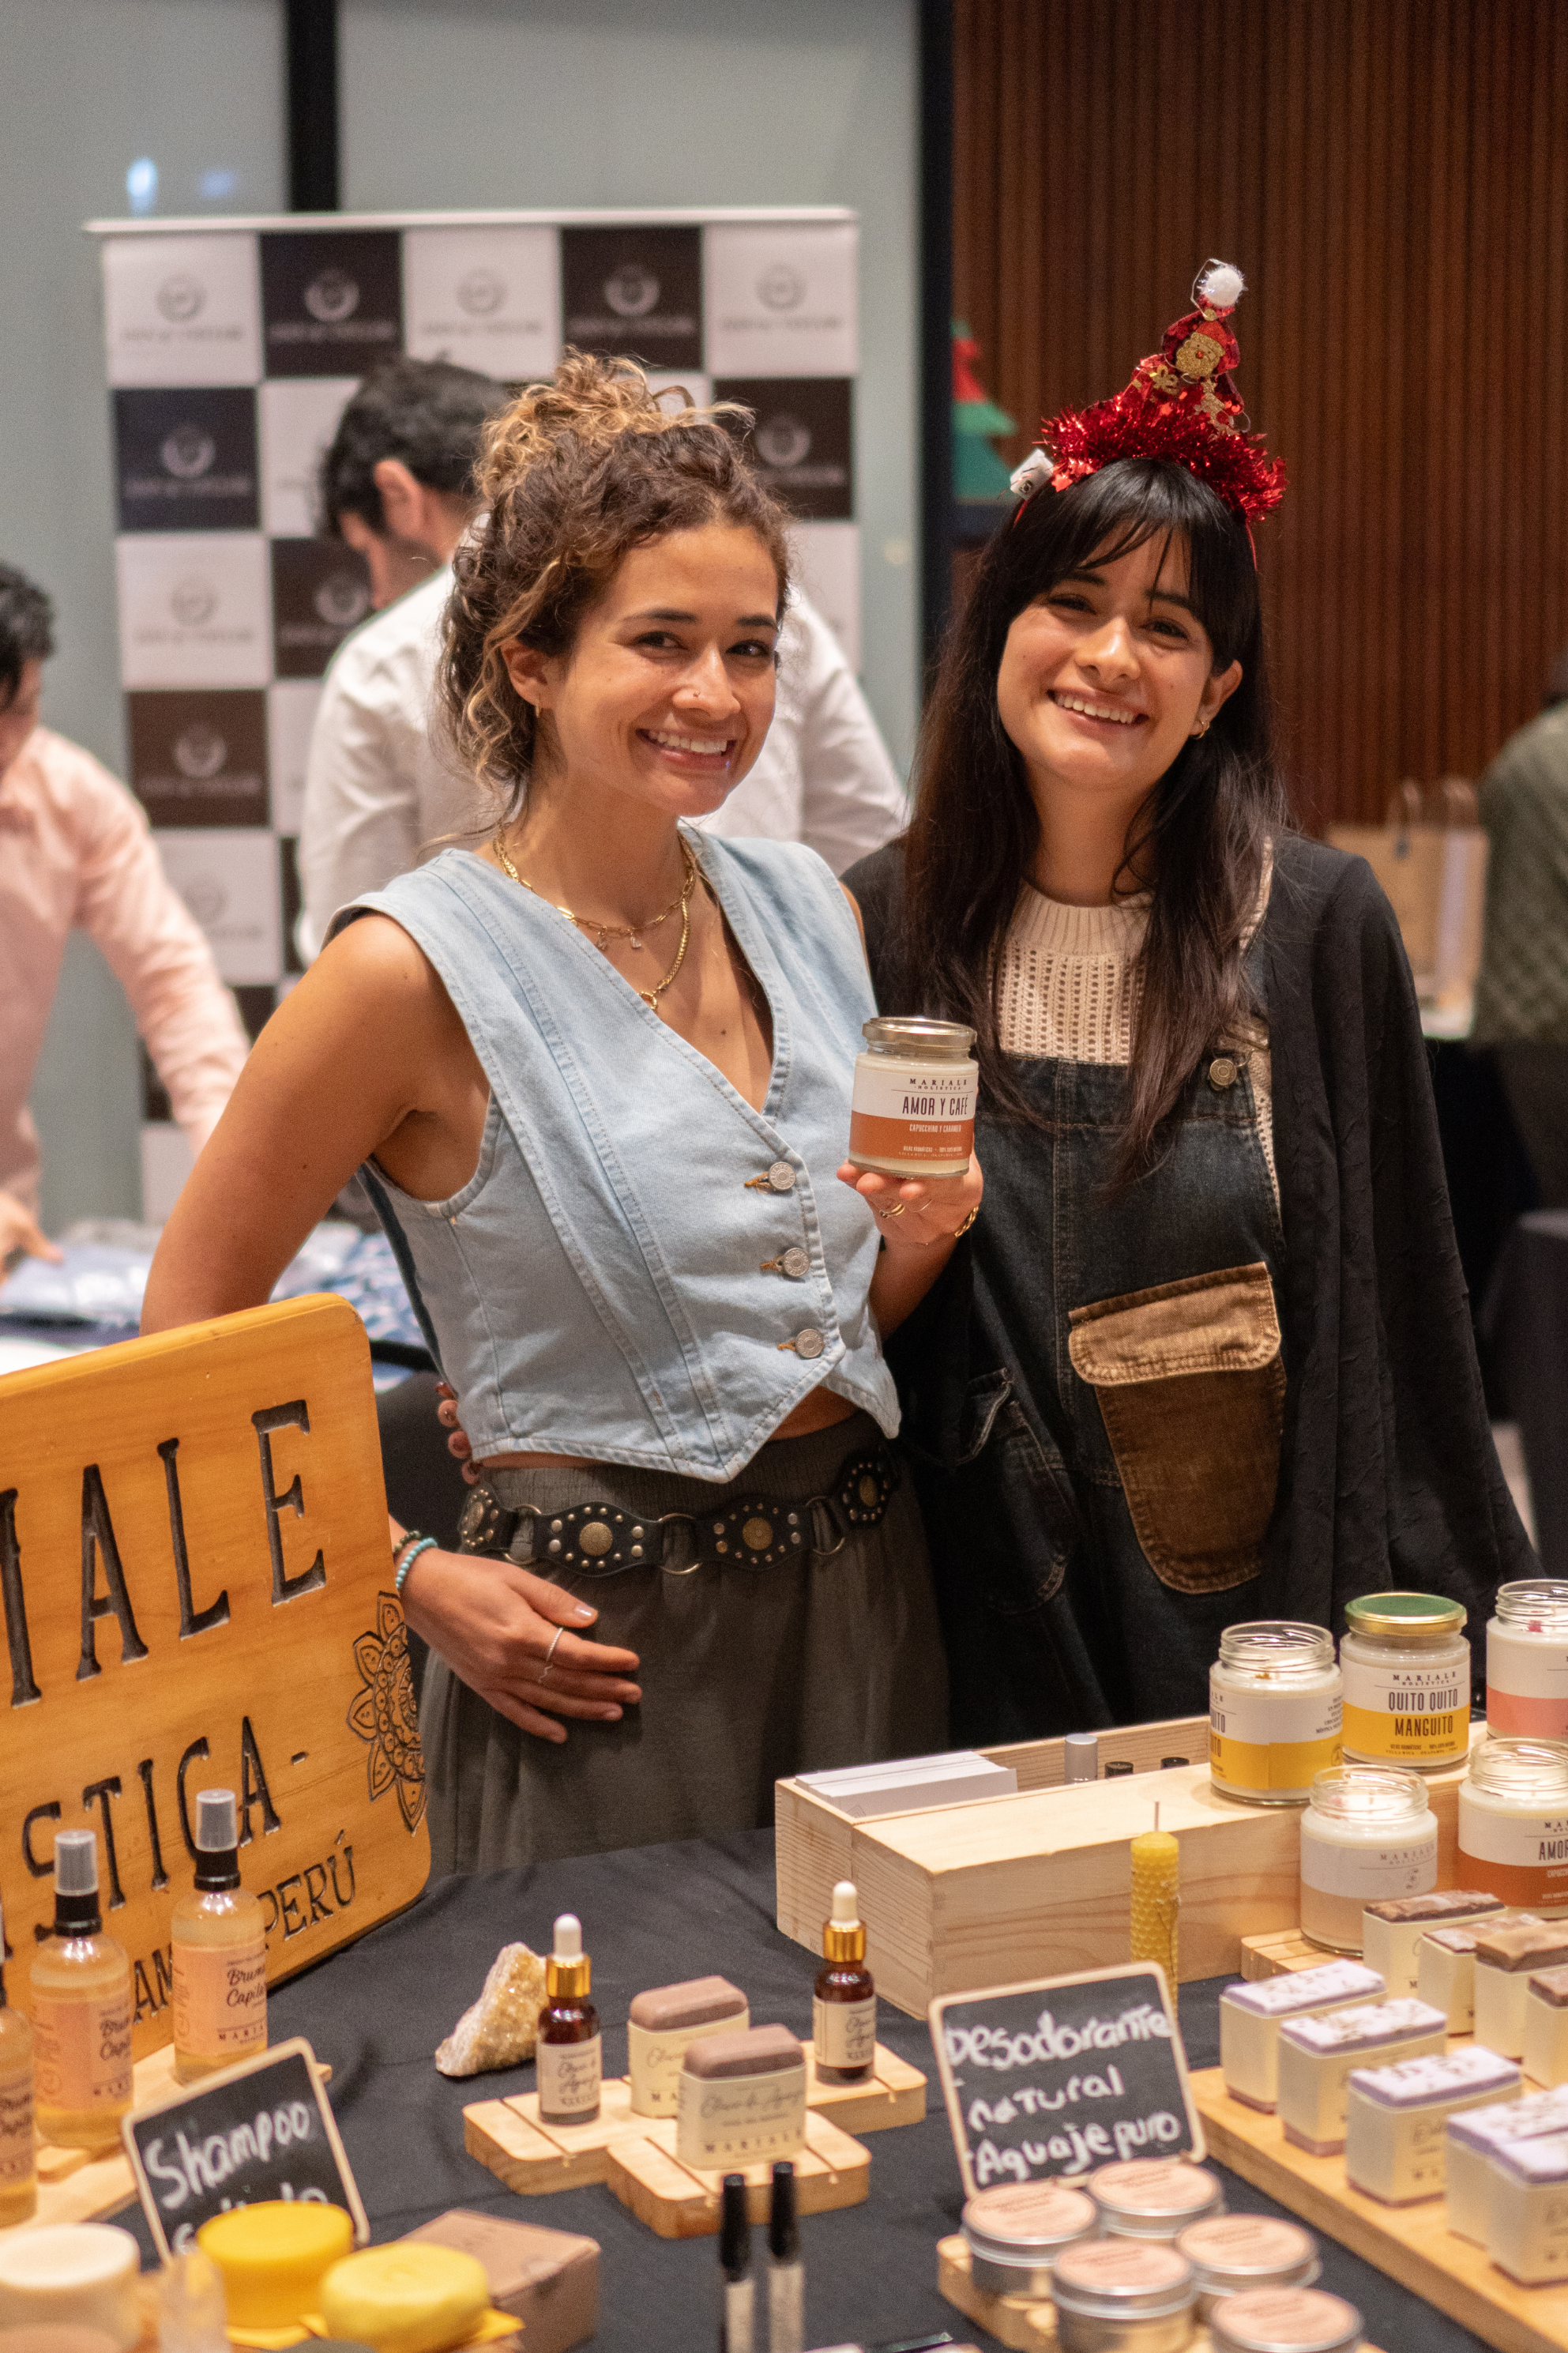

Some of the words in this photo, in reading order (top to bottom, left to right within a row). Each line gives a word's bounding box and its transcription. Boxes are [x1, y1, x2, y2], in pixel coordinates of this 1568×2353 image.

[902, 1096, 934, 1116] AMOR
[941, 1098, 946, 1116] Y
[949, 1094, 968, 1116] CAFÉ
[1393, 1671, 1456, 1681] MARIALE
[1389, 1692, 1424, 1711] QUITO
[1430, 1689, 1458, 1711] QUITO
[1395, 1715, 1453, 1737] MANGUITO
[145, 2101, 310, 2209] Shampoo
